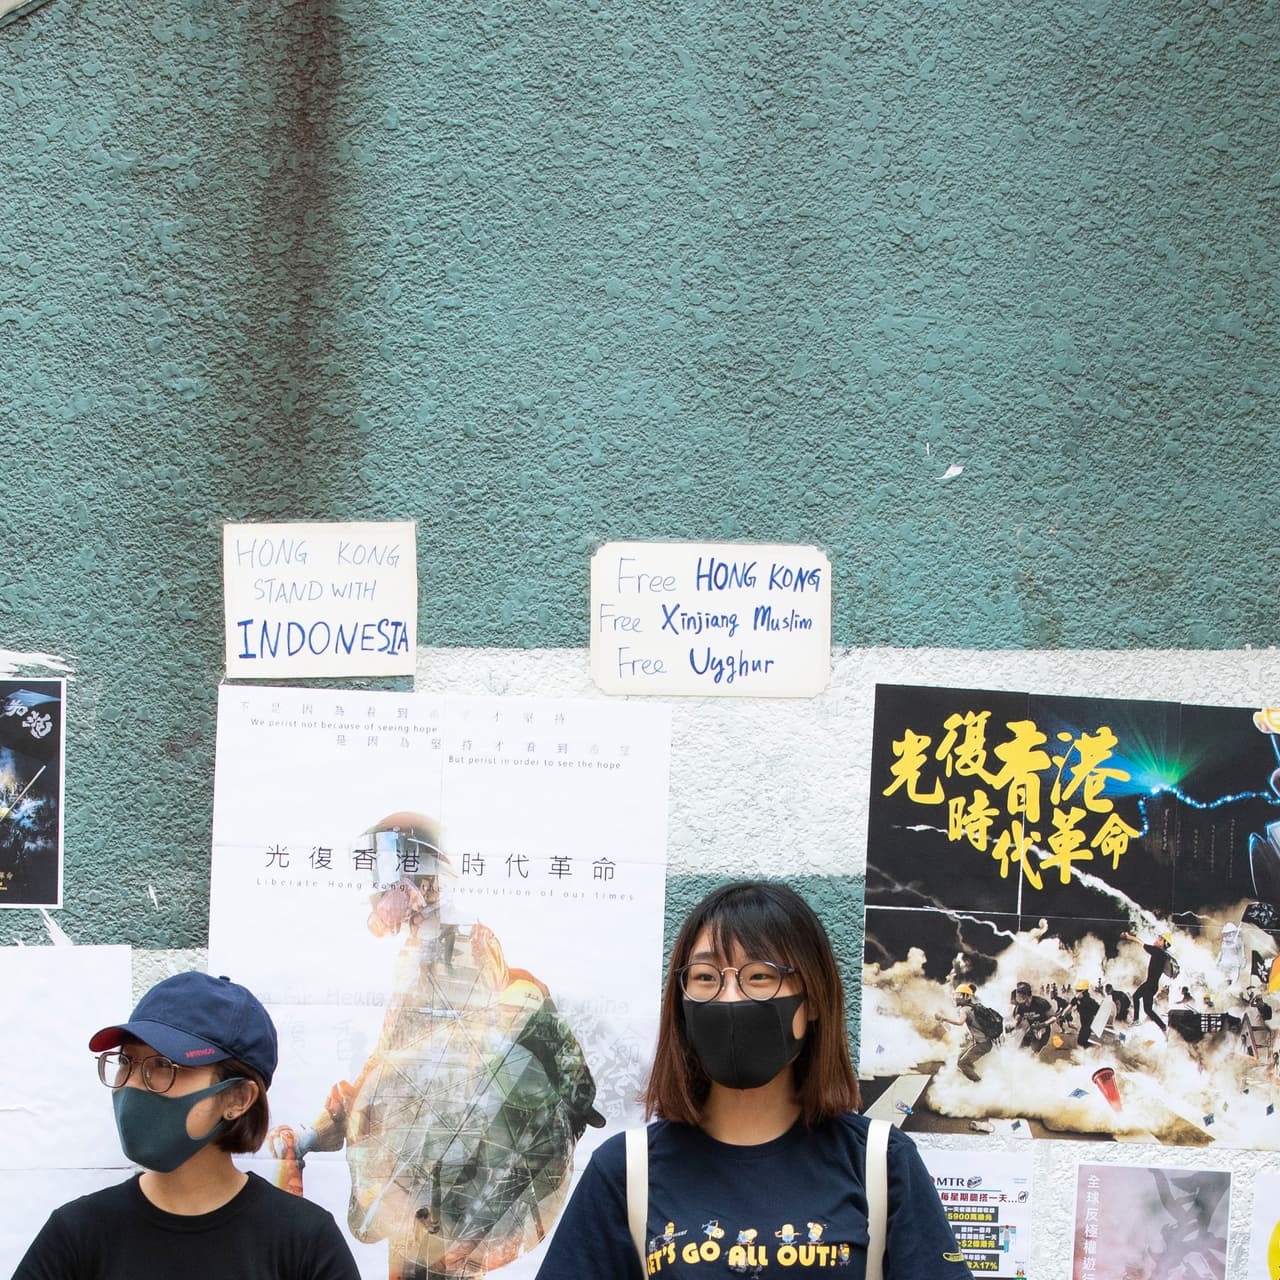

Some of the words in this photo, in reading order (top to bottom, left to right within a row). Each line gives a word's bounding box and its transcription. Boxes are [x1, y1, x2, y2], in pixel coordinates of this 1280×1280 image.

[236, 538, 308, 568] HONG
[337, 540, 400, 568] KONG
[253, 577, 323, 604] STAND
[331, 579, 377, 601] WITH
[617, 556, 677, 593] Free
[695, 557, 757, 591] HONG
[768, 562, 822, 593] KONG
[236, 618, 409, 659] INDONESIA
[599, 603, 642, 633] Free
[661, 603, 740, 638] Xinjiang
[753, 605, 813, 633] Muslim
[618, 646, 668, 679] Free
[689, 647, 775, 684] Uyghur
[413, 724, 438, 735] hope
[883, 710, 1131, 823] 光復香港
[948, 789, 1140, 890] 時代革命
[265, 843, 422, 875] 光復香港
[461, 852, 616, 882] 時代革命
[936, 1177, 965, 1187] MTR
[681, 1240, 721, 1264] GO
[728, 1244, 769, 1267] ALL
[776, 1244, 838, 1267] OUT!
